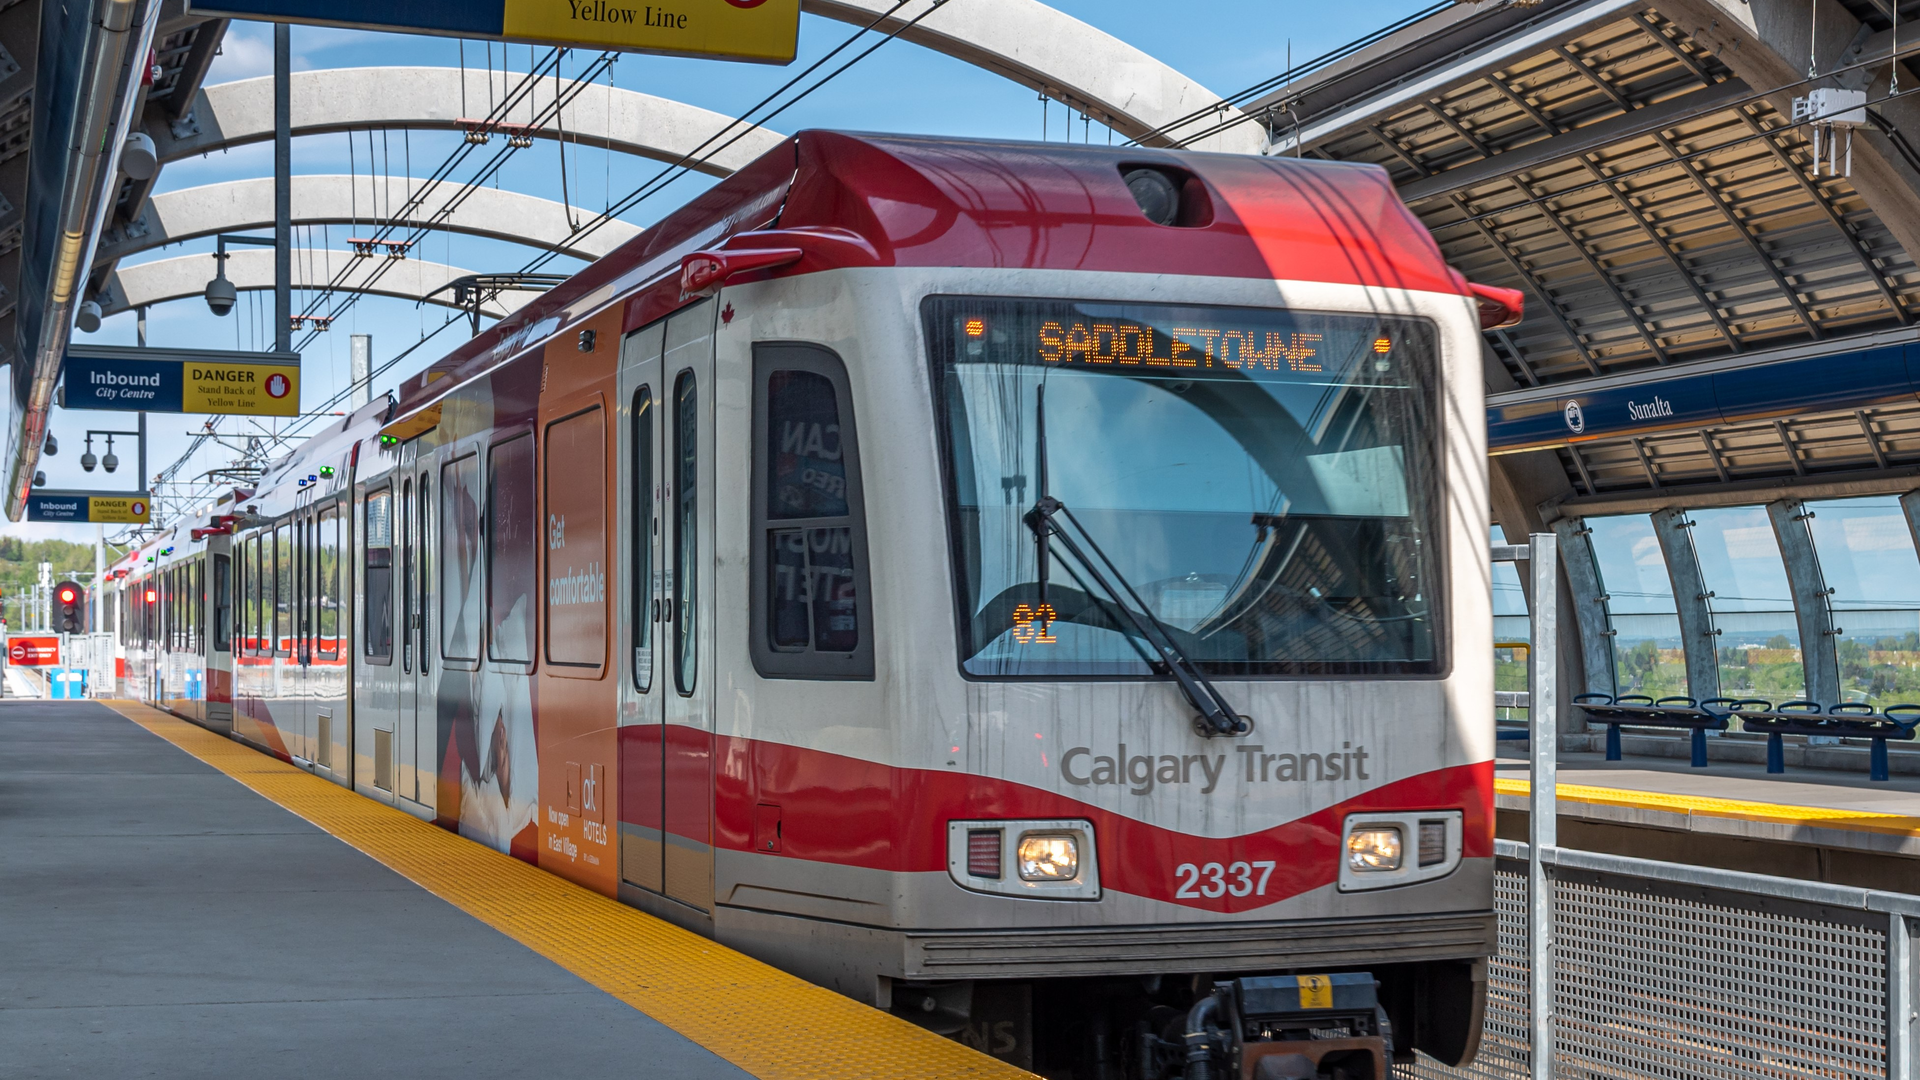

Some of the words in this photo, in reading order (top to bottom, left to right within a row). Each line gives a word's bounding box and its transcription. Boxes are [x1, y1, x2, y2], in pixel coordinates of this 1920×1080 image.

[568, 0, 637, 25] Yellow
[644, 6, 688, 29] Line
[1039, 321, 1323, 372] SADDLETOWNE
[90, 371, 161, 387] Inbound
[192, 369, 255, 382] DANGER
[96, 387, 117, 400] City
[120, 388, 155, 399] Centre
[198, 385, 222, 395] Stand
[224, 386, 245, 395] Back
[247, 386, 256, 396] of
[207, 398, 235, 408] Yellow
[238, 398, 256, 408] Line
[1628, 395, 1674, 421] Sunalta
[40, 502, 77, 510] Inbound
[549, 513, 565, 550] Get
[549, 561, 604, 606] comfortable
[1013, 604, 1056, 644] 82
[1061, 744, 1226, 796] Calgary
[1237, 741, 1370, 782] Transit
[548, 805, 557, 824] Now
[558, 811, 569, 831] open
[583, 818, 607, 846] HOTELS
[548, 832, 553, 849] in
[553, 833, 562, 853] East
[563, 836, 577, 862] Village
[1175, 860, 1276, 899] 2337
